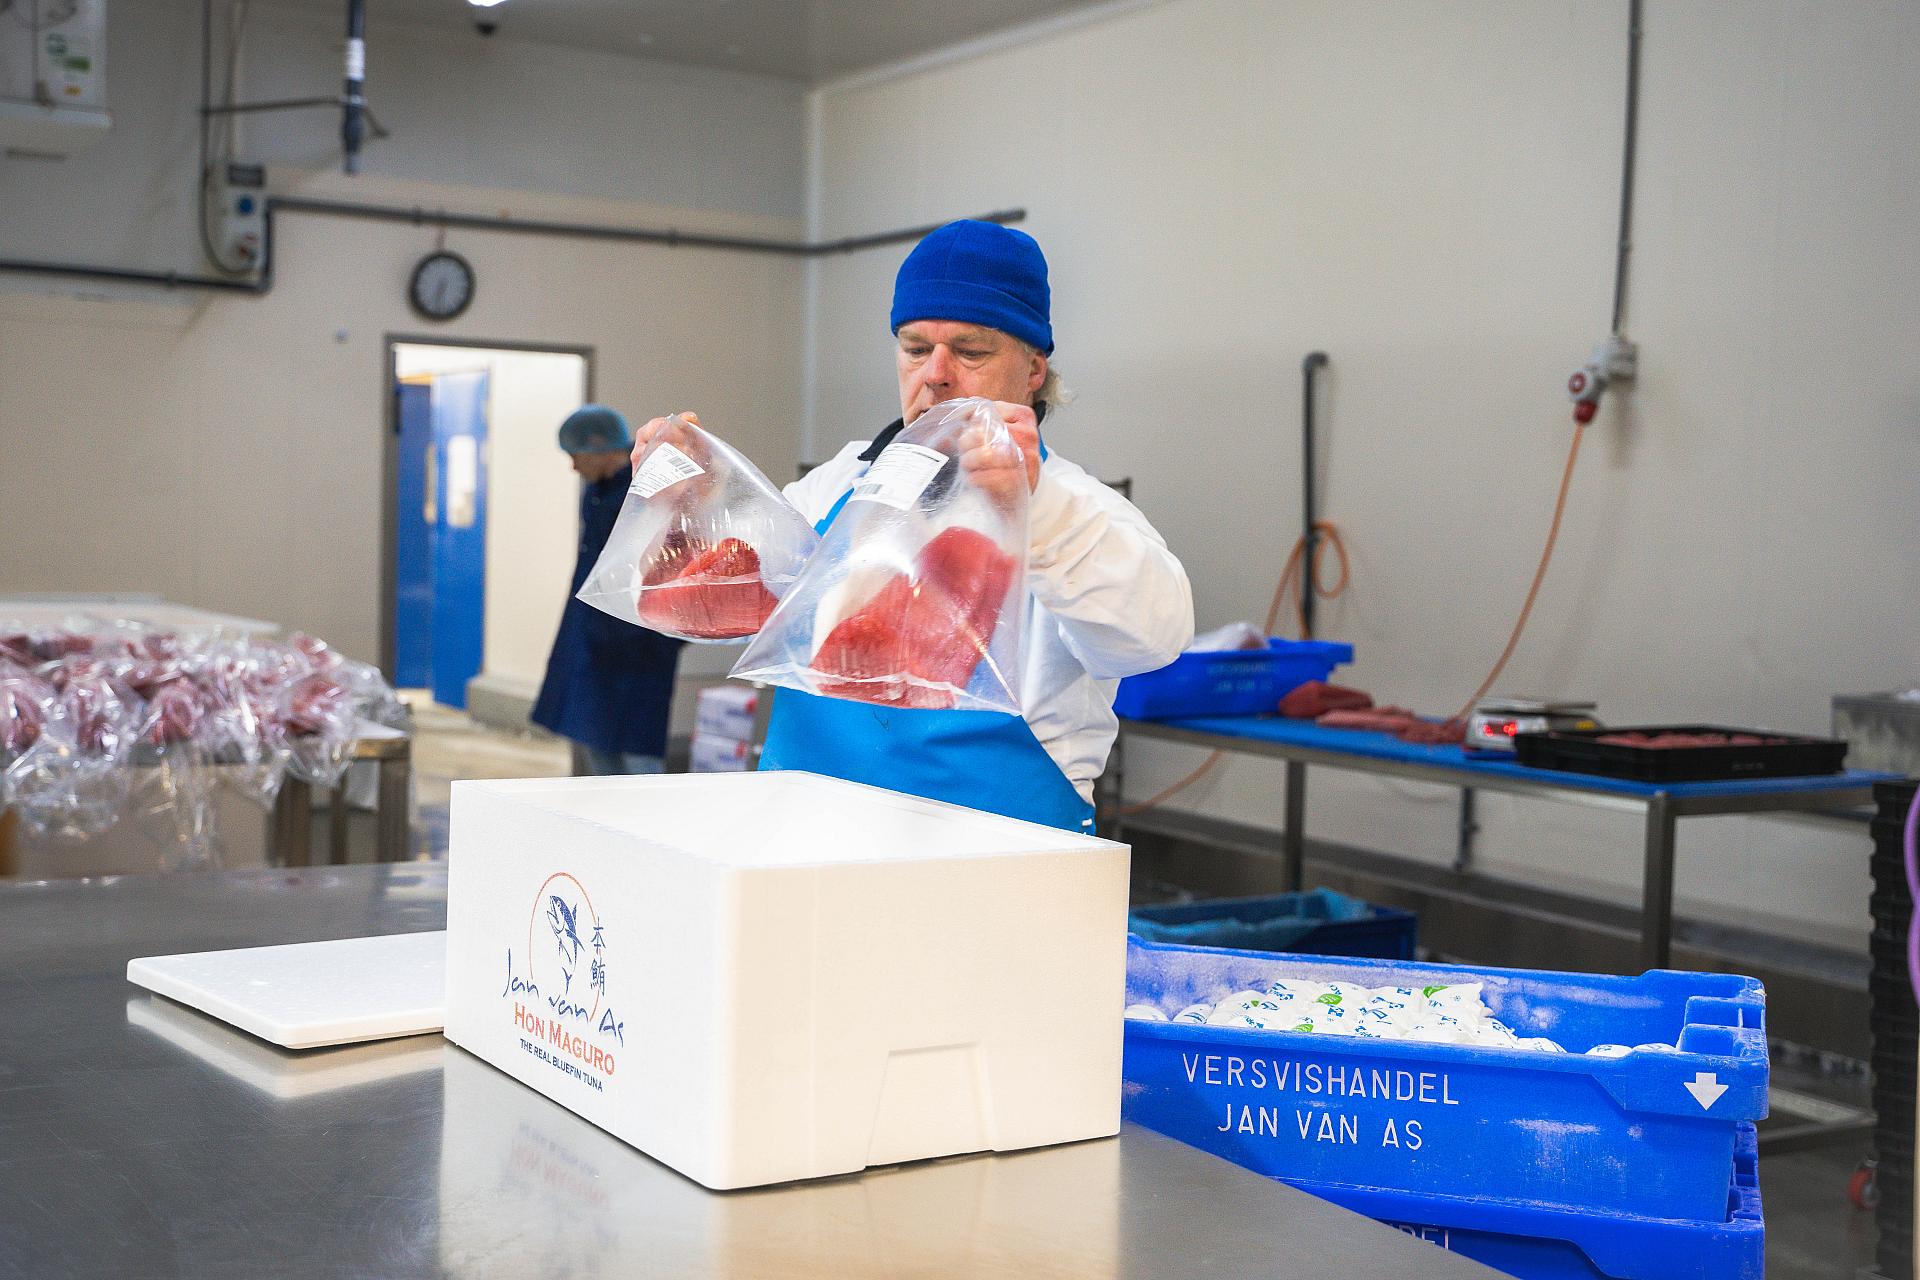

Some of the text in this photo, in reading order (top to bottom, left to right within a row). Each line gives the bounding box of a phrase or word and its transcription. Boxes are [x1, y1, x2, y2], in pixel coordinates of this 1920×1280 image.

[503, 948, 539, 998] Jan
[548, 994, 589, 1023] van
[514, 1001, 615, 1076] HON MAGURO
[520, 1038, 603, 1092] THE REAL BLUEFIN TUNA
[1182, 1053, 1459, 1105] VERSVISHANDEL
[1217, 1103, 1423, 1151] JAN VAN AS
